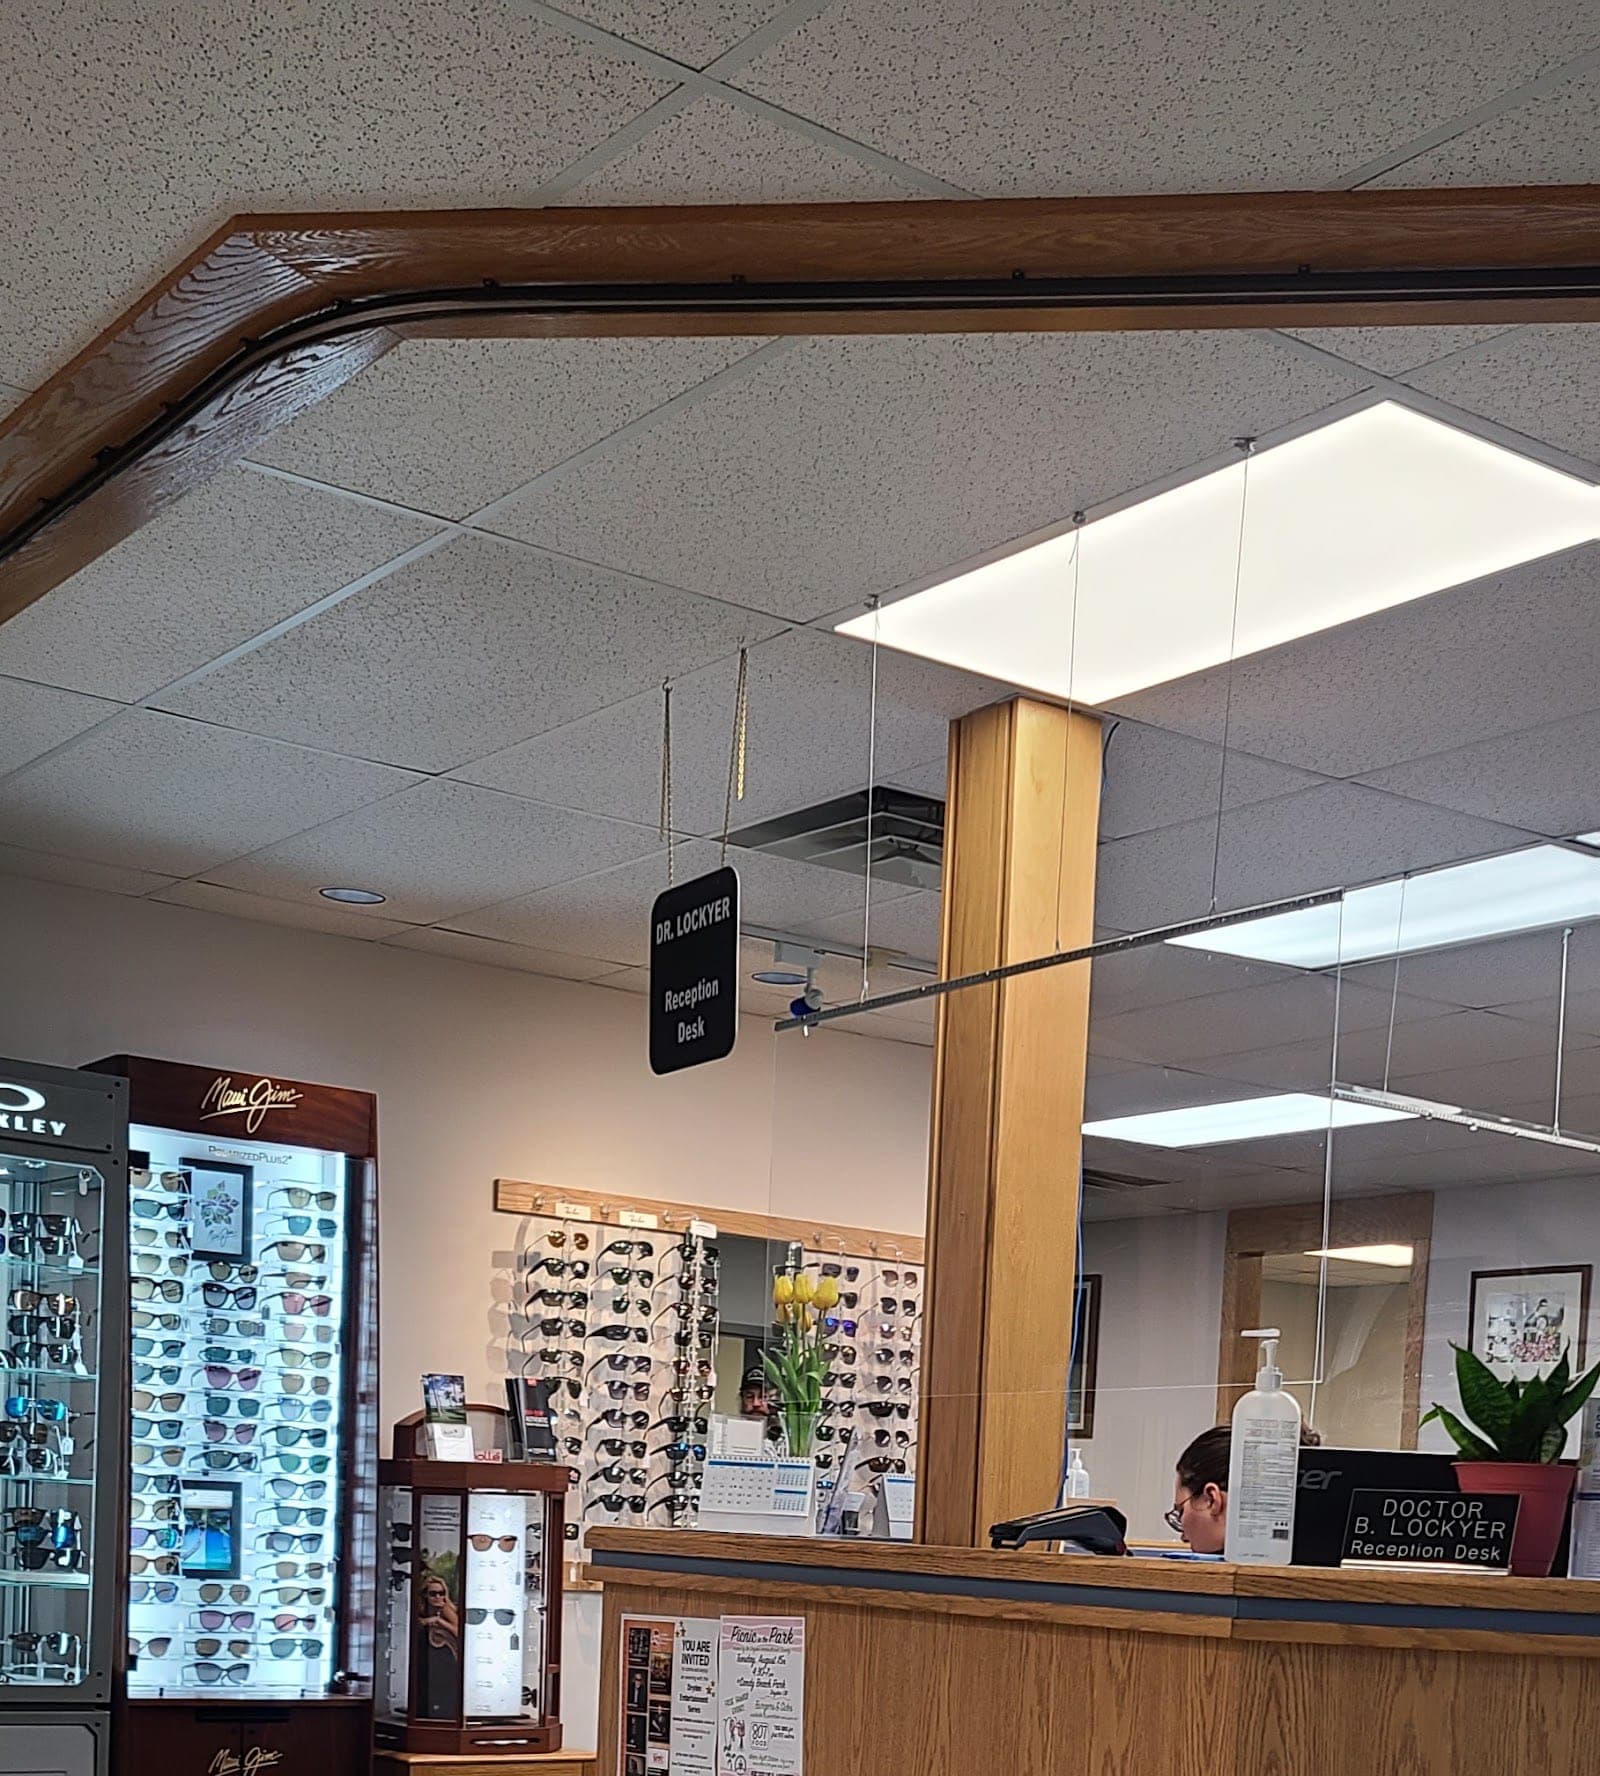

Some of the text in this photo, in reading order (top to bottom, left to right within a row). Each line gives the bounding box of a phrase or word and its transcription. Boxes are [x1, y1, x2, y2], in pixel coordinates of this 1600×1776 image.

[656, 896, 730, 945] DR. LOCKYER
[665, 976, 719, 1012] Reception
[677, 1016, 705, 1043] Desk
[200, 1077, 303, 1133] Maui Jim
[1383, 1499, 1483, 1519] DOCTOR
[1354, 1517, 1506, 1539] B. LOCKYER
[1351, 1540, 1500, 1561] Reception Desk
[730, 1626, 757, 1643] Picnic
[769, 1627, 794, 1644] Park
[682, 1639, 711, 1653] YOU ARE
[681, 1653, 709, 1666] INVITED
